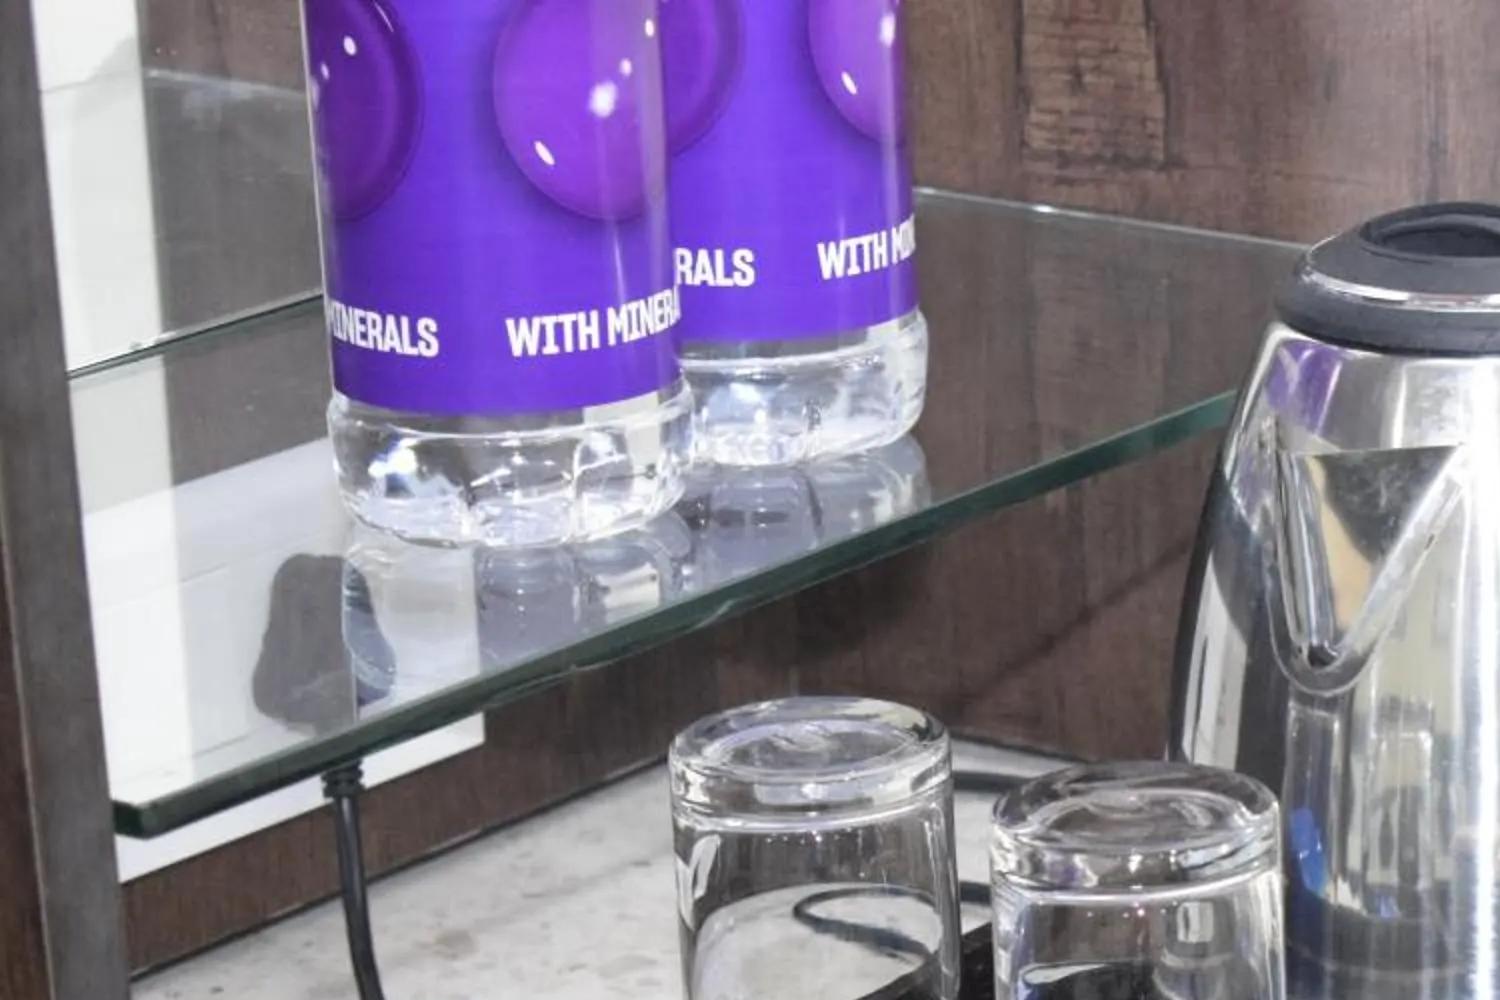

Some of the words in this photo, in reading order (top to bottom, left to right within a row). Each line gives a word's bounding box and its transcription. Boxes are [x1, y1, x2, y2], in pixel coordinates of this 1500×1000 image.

[674, 247, 756, 287] RALS
[816, 230, 888, 280] WITH
[505, 310, 600, 357] WITH
